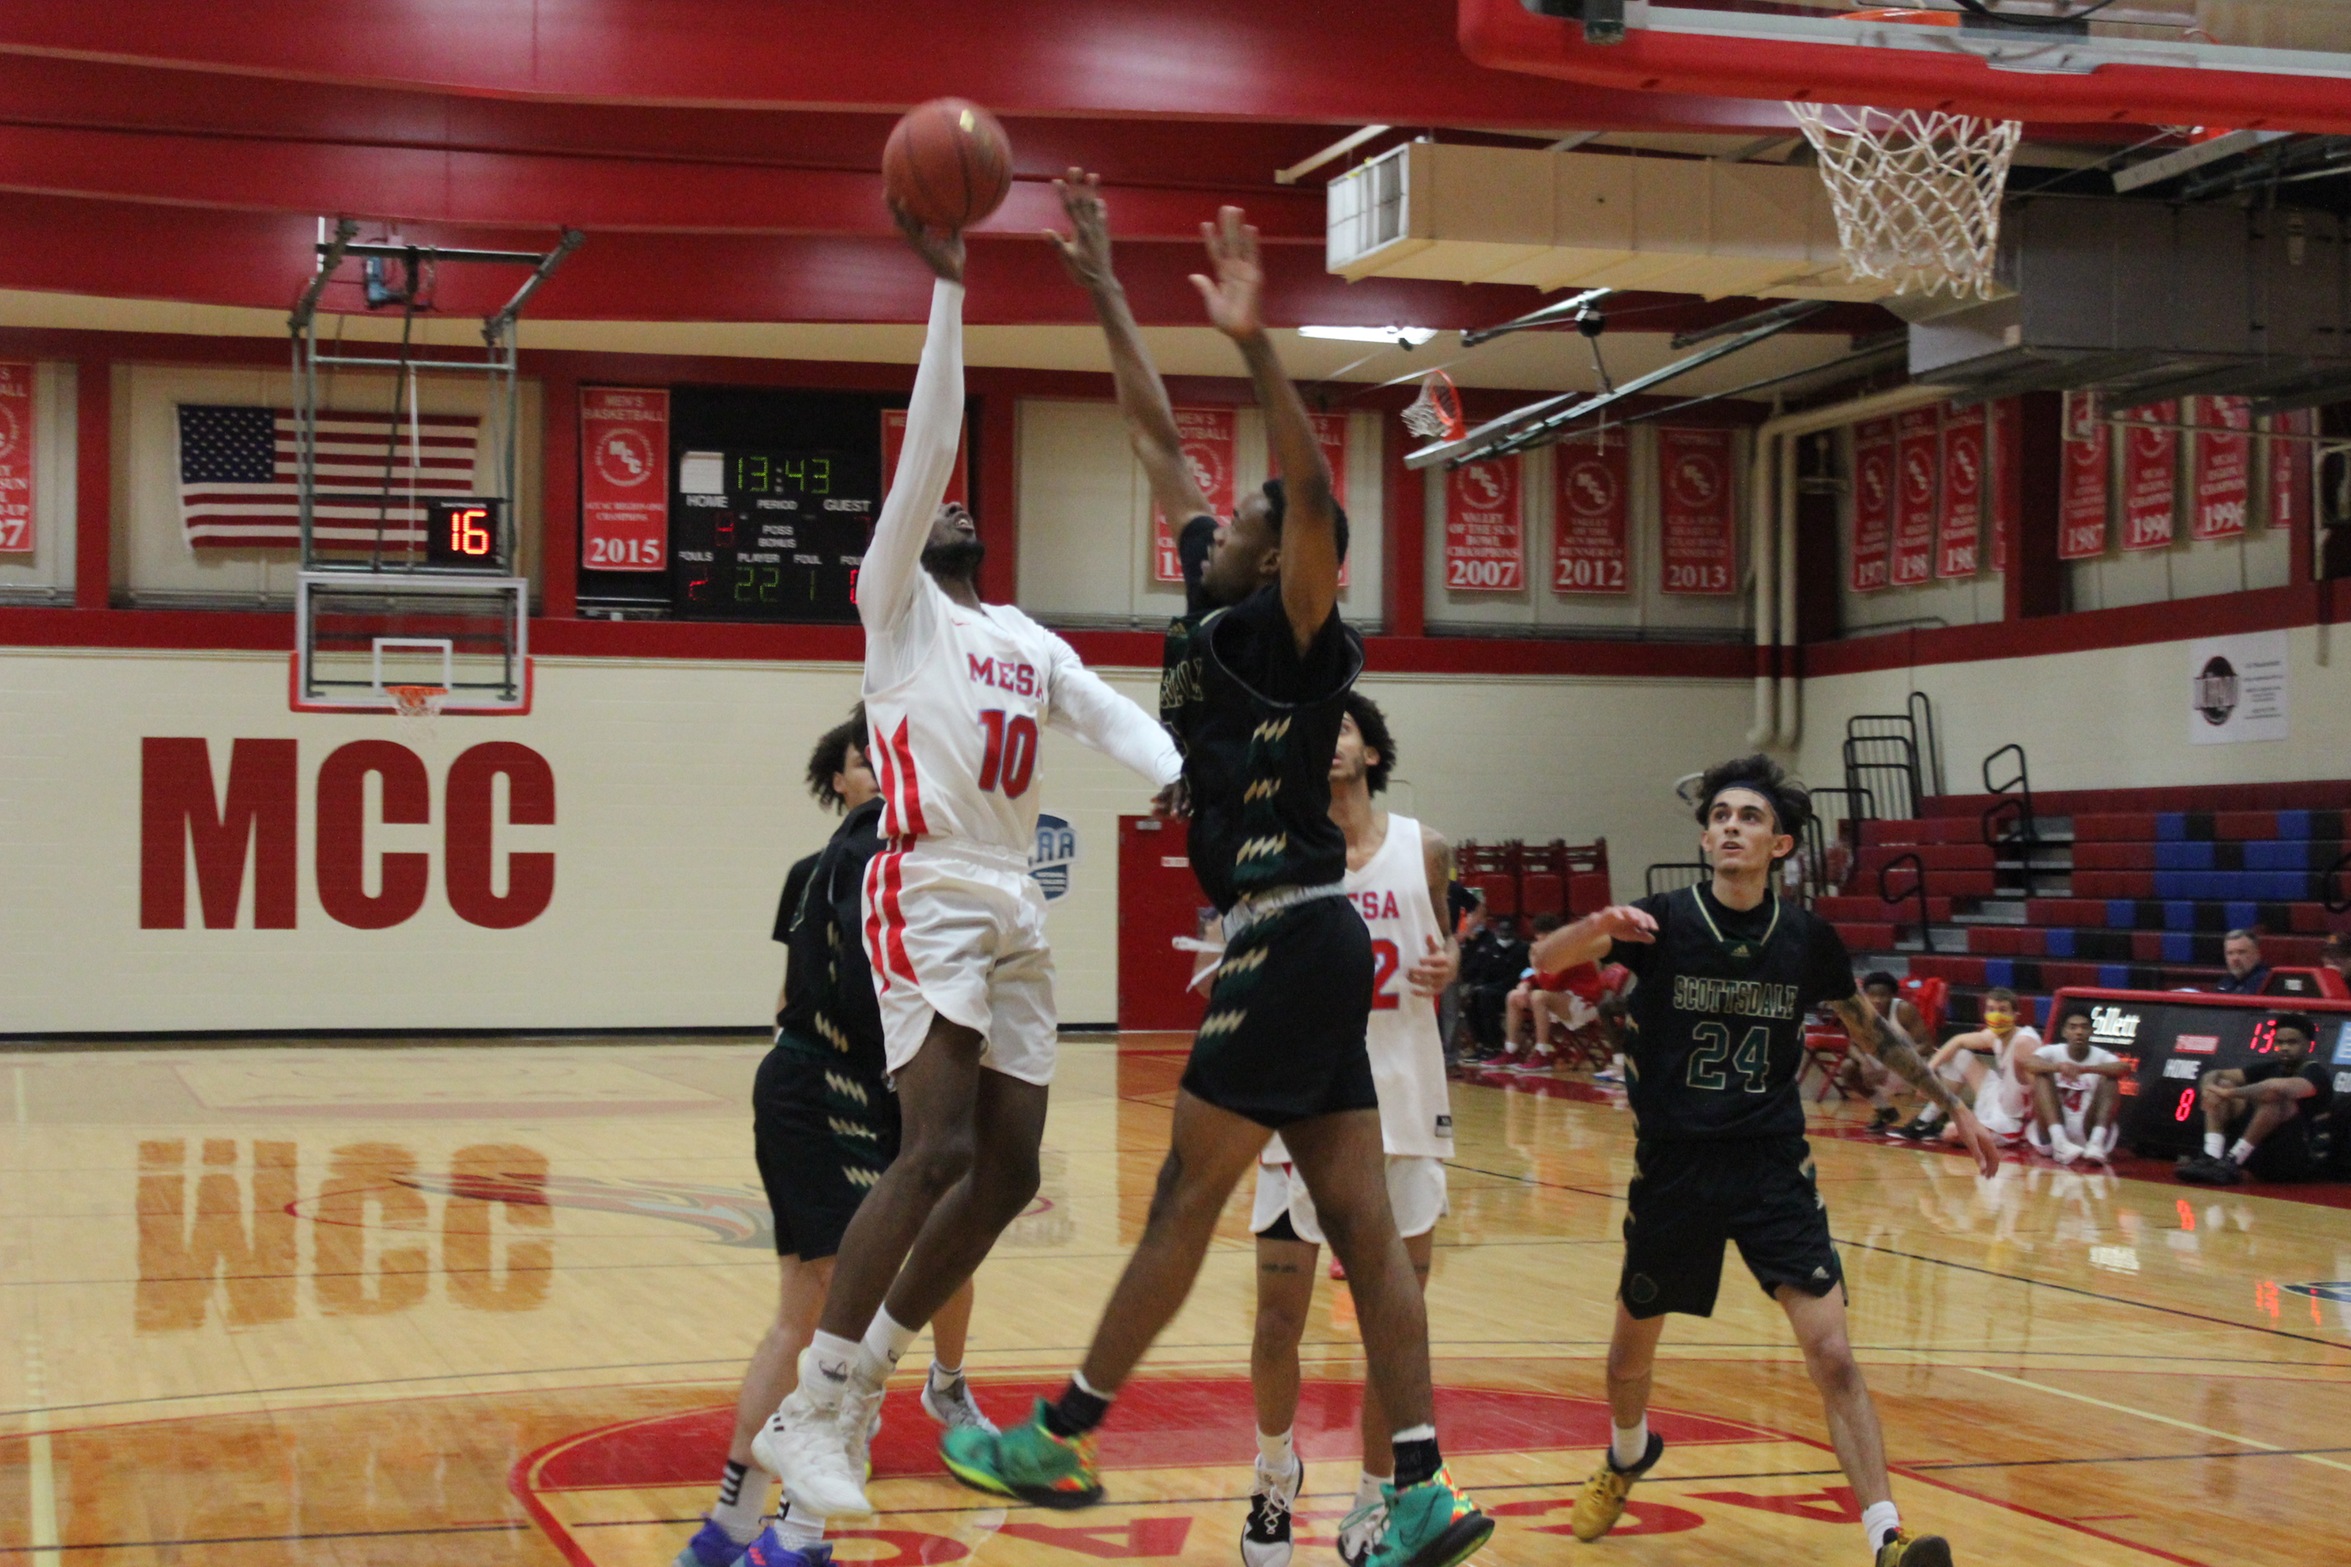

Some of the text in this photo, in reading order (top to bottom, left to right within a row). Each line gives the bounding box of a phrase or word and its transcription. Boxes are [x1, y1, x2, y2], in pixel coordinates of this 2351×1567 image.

[686, 495, 728, 508] HOME
[756, 499, 798, 510] PERIOD
[823, 499, 872, 512] GUEST
[451, 509, 490, 556] 16
[762, 525, 794, 535] POSS
[591, 537, 661, 564] 2015
[758, 538, 797, 549] BONUS
[678, 551, 714, 562] FOULS
[737, 553, 780, 563] PLAYER
[793, 554, 823, 565] FOUL
[735, 567, 780, 602] 22
[1450, 559, 1517, 587] 2007
[1557, 558, 1624, 587] 2012
[1668, 565, 1728, 589] 2013
[978, 708, 1038, 800] 10
[139, 737, 556, 930] MCC
[1673, 975, 1799, 1020] SCOTTSDALE
[1686, 1021, 1771, 1094] 24
[2162, 1059, 2201, 1081] HOME
[2174, 1088, 2196, 1122] 8
